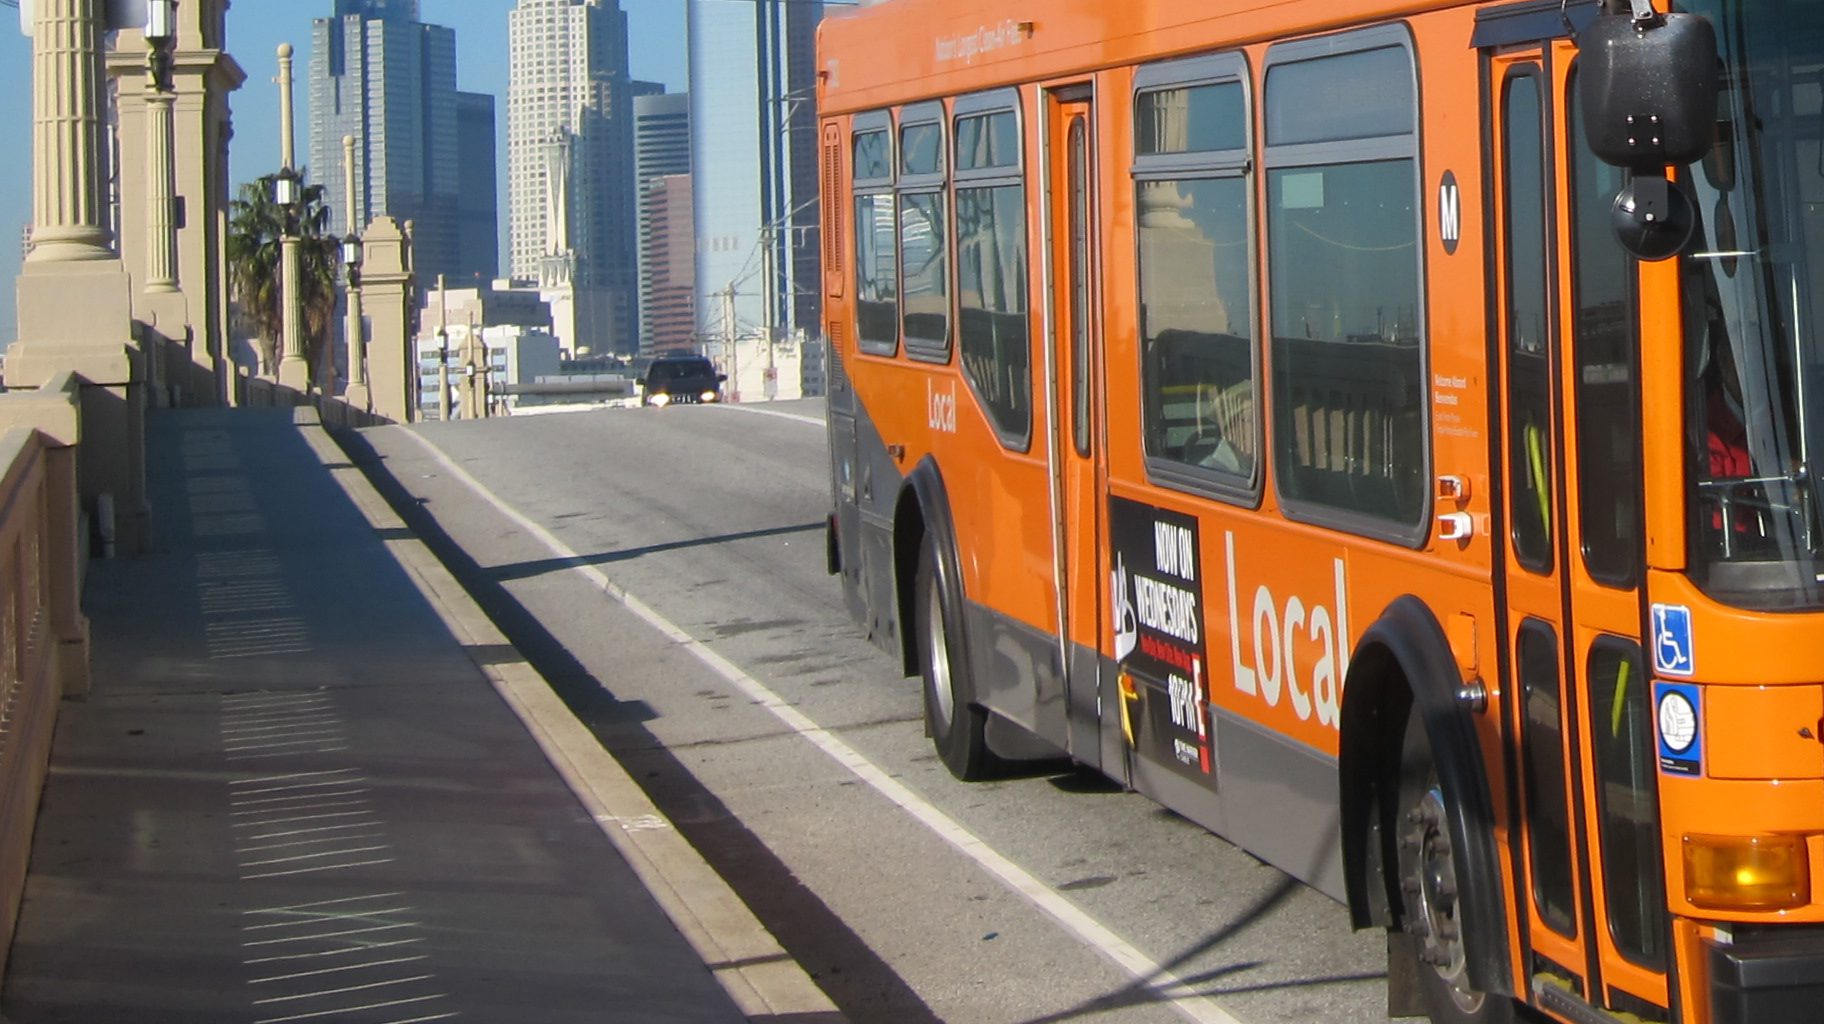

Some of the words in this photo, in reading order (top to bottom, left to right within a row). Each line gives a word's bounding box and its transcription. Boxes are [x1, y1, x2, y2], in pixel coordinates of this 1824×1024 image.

[1440, 185, 1458, 240] M
[927, 377, 957, 434] Local
[1154, 521, 1178, 576] NOW
[1178, 526, 1194, 581] ON
[1133, 574, 1198, 645] WEDNESDAYS
[1225, 530, 1350, 731] Local
[1168, 673, 1197, 733] 10PM
